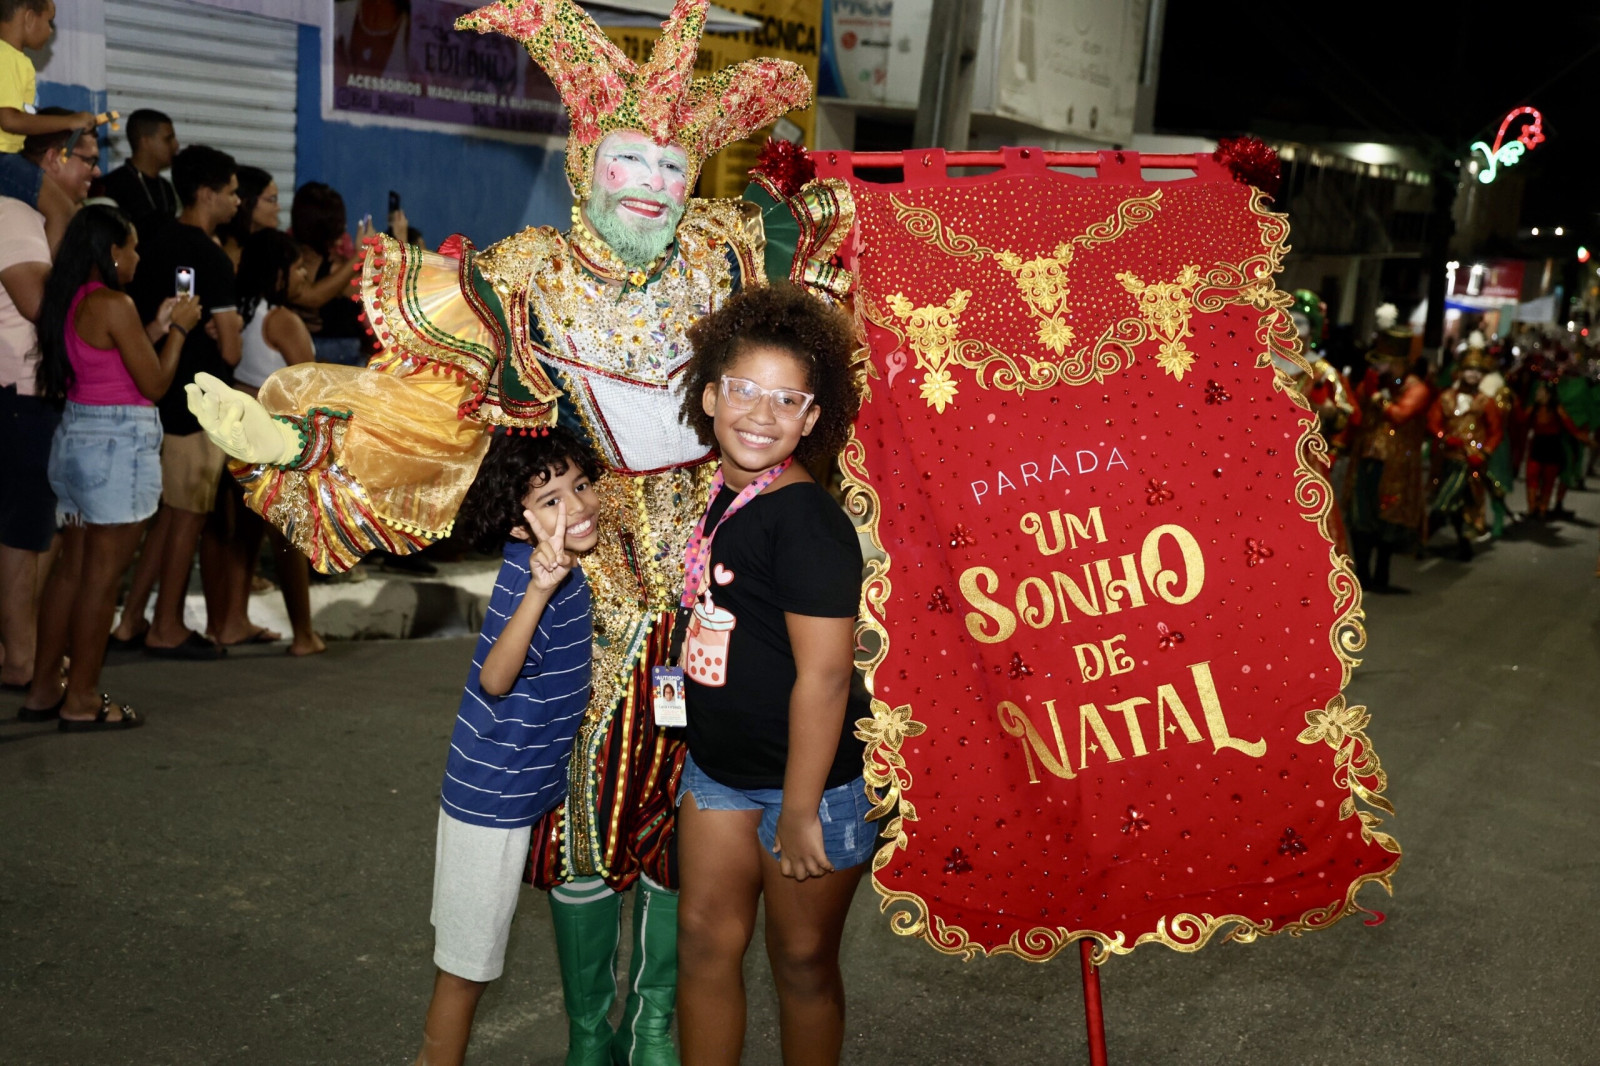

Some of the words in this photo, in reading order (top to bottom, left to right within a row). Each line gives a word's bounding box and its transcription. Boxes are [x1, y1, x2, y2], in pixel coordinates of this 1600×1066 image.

[970, 447, 1129, 505] PARADA
[1019, 506, 1108, 556] UM
[958, 523, 1205, 644] SONHO
[1072, 633, 1135, 683] DE
[996, 660, 1267, 784] NATAL
